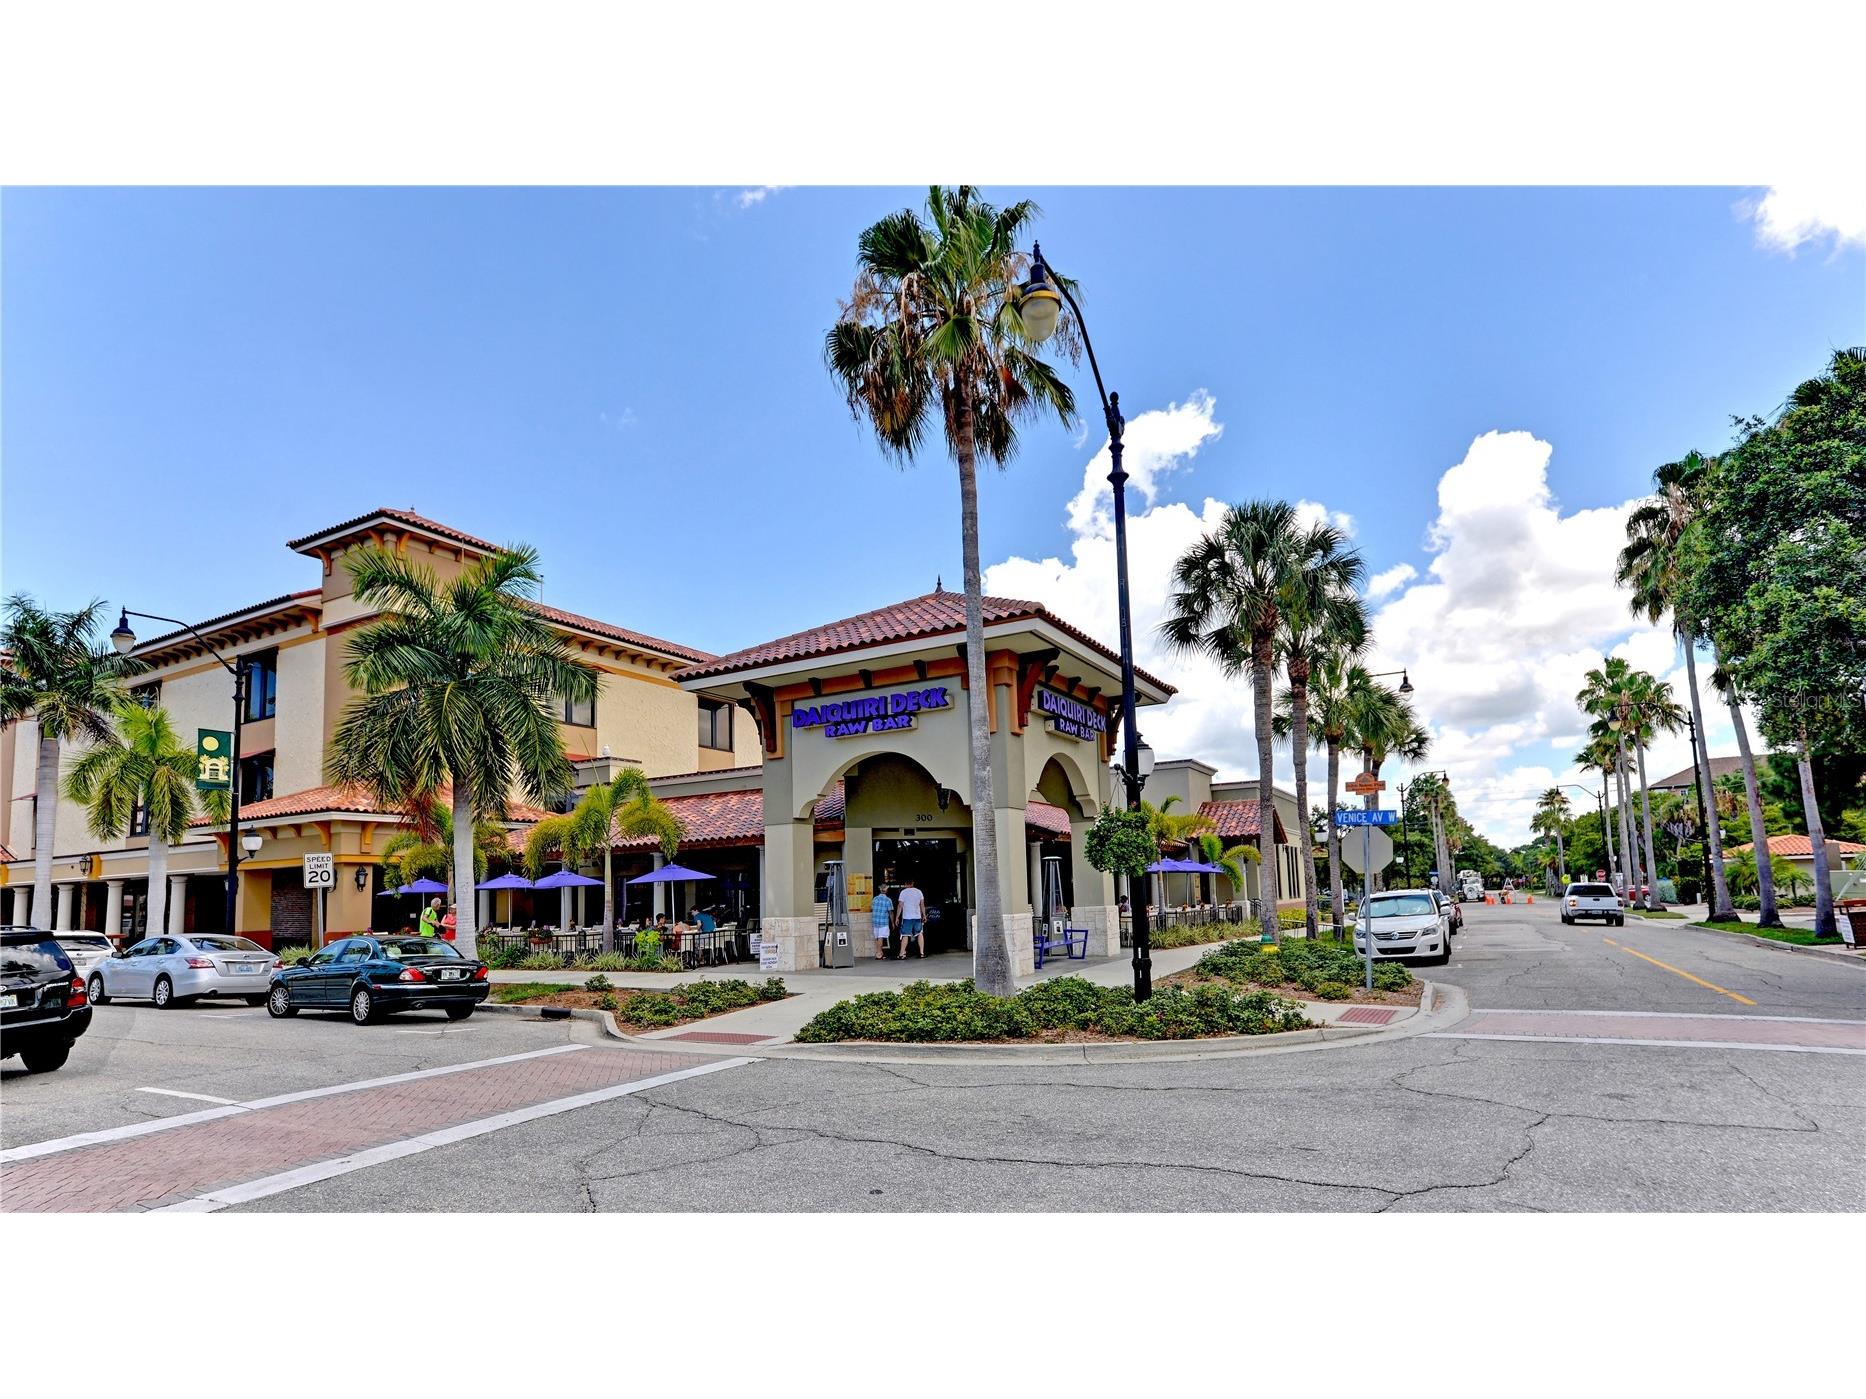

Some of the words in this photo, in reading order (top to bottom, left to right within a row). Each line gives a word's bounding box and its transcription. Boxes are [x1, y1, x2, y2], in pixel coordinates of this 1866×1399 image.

[793, 696, 888, 728] DAIQUIRI
[890, 687, 949, 714] DECK
[1043, 690, 1086, 725] DAIQUIRI
[1086, 711, 1106, 732] DECK
[825, 719, 868, 737] RAW
[871, 714, 912, 732] BAR
[1060, 718, 1078, 735] RAW
[1080, 726, 1096, 740] BAR
[915, 814, 933, 822] 300
[1336, 812, 1368, 823] VENICE
[1371, 812, 1384, 823] AV
[1388, 811, 1396, 822] W
[308, 870, 331, 883] 20
